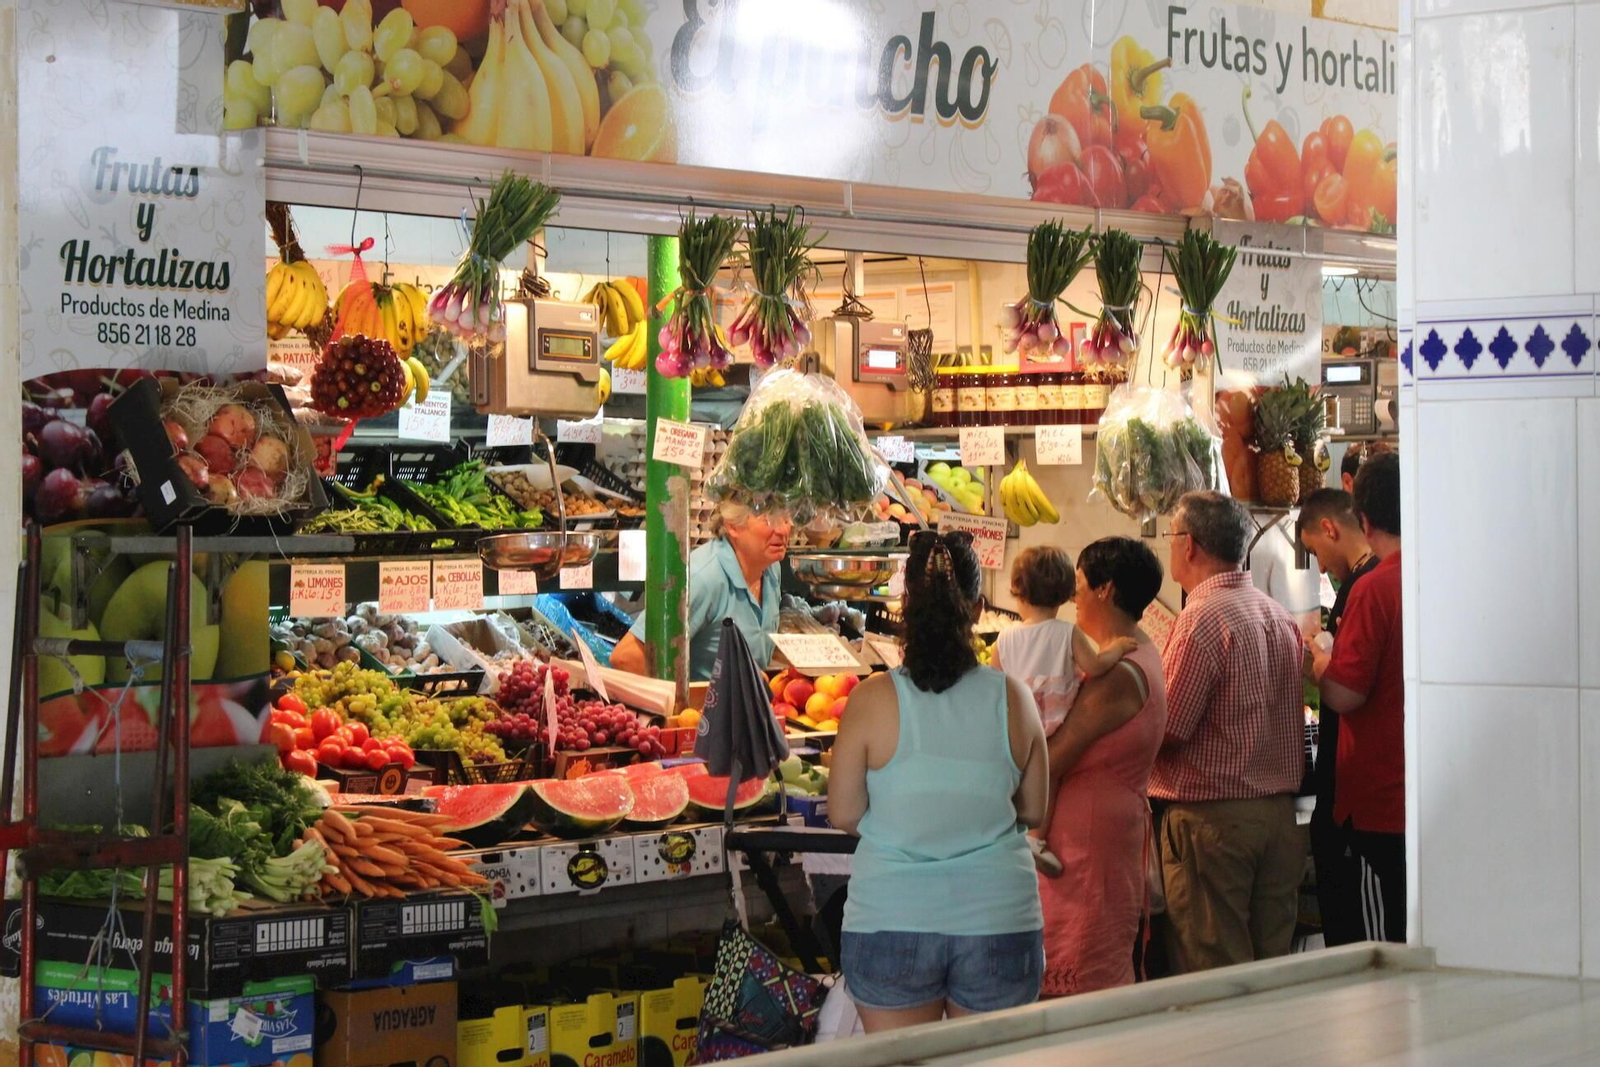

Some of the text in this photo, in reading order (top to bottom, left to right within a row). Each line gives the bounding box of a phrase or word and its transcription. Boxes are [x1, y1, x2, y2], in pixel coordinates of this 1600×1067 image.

[1167, 5, 1267, 76] Frutas
[1275, 41, 1293, 94] y
[90, 146, 200, 198] Frutas
[136, 202, 156, 242] y
[1240, 235, 1292, 268] Frutas
[59, 239, 231, 291] Hortalizas
[1260, 272, 1270, 300] y
[60, 292, 230, 322] Productos de Medina
[1227, 300, 1306, 333] Hortalizas
[97, 322, 131, 345] 856
[175, 325, 197, 347] 28
[1227, 337, 1265, 354] Productos
[1266, 339, 1276, 354] de
[283, 352, 321, 363] PATATAS
[415, 408, 446, 416] ITALIANOS
[670, 427, 698, 439] OREGANO
[307, 577, 344, 589] LIMONES
[395, 575, 428, 586] AJOS
[448, 571, 481, 583] CEBOLLAS
[48, 988, 129, 1009] Las Virtudes
[276, 1018, 289, 1032] LAS
[372, 1004, 436, 1032] AGRAGUA
[619, 1022, 624, 1038] 2
[529, 1034, 536, 1050] 2
[584, 1047, 635, 1067] Caramelo
